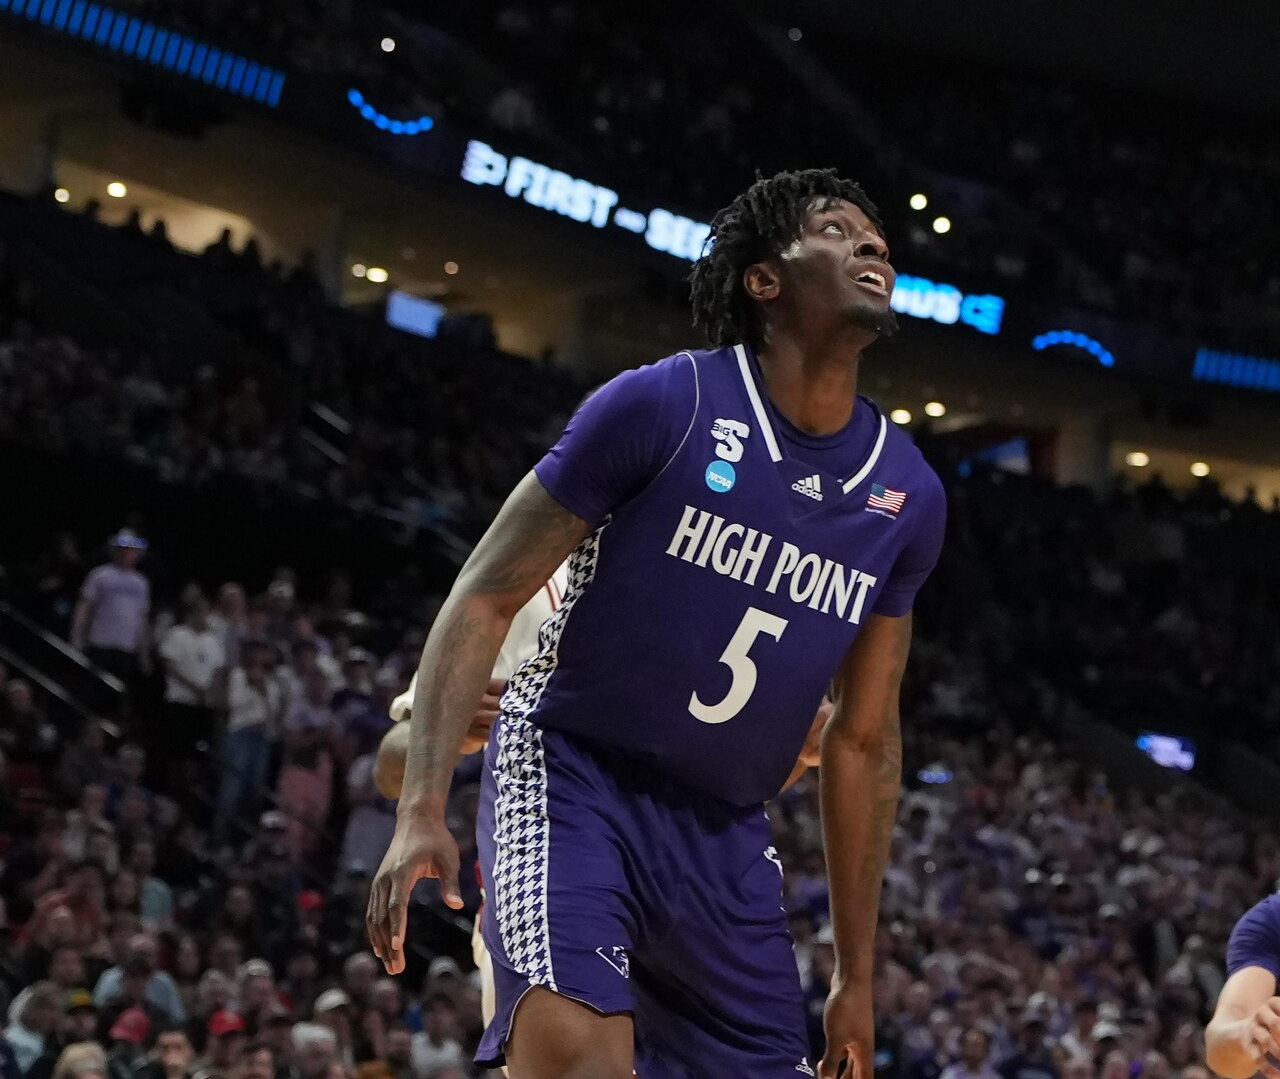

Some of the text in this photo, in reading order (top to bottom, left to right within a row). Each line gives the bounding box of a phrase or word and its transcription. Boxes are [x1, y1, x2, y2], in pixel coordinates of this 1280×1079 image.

[505, 156, 619, 229] FIRST
[706, 471, 732, 490] NCAA
[791, 482, 824, 502] adidas
[665, 504, 878, 625] HIGH POINT
[688, 606, 789, 724] 5
